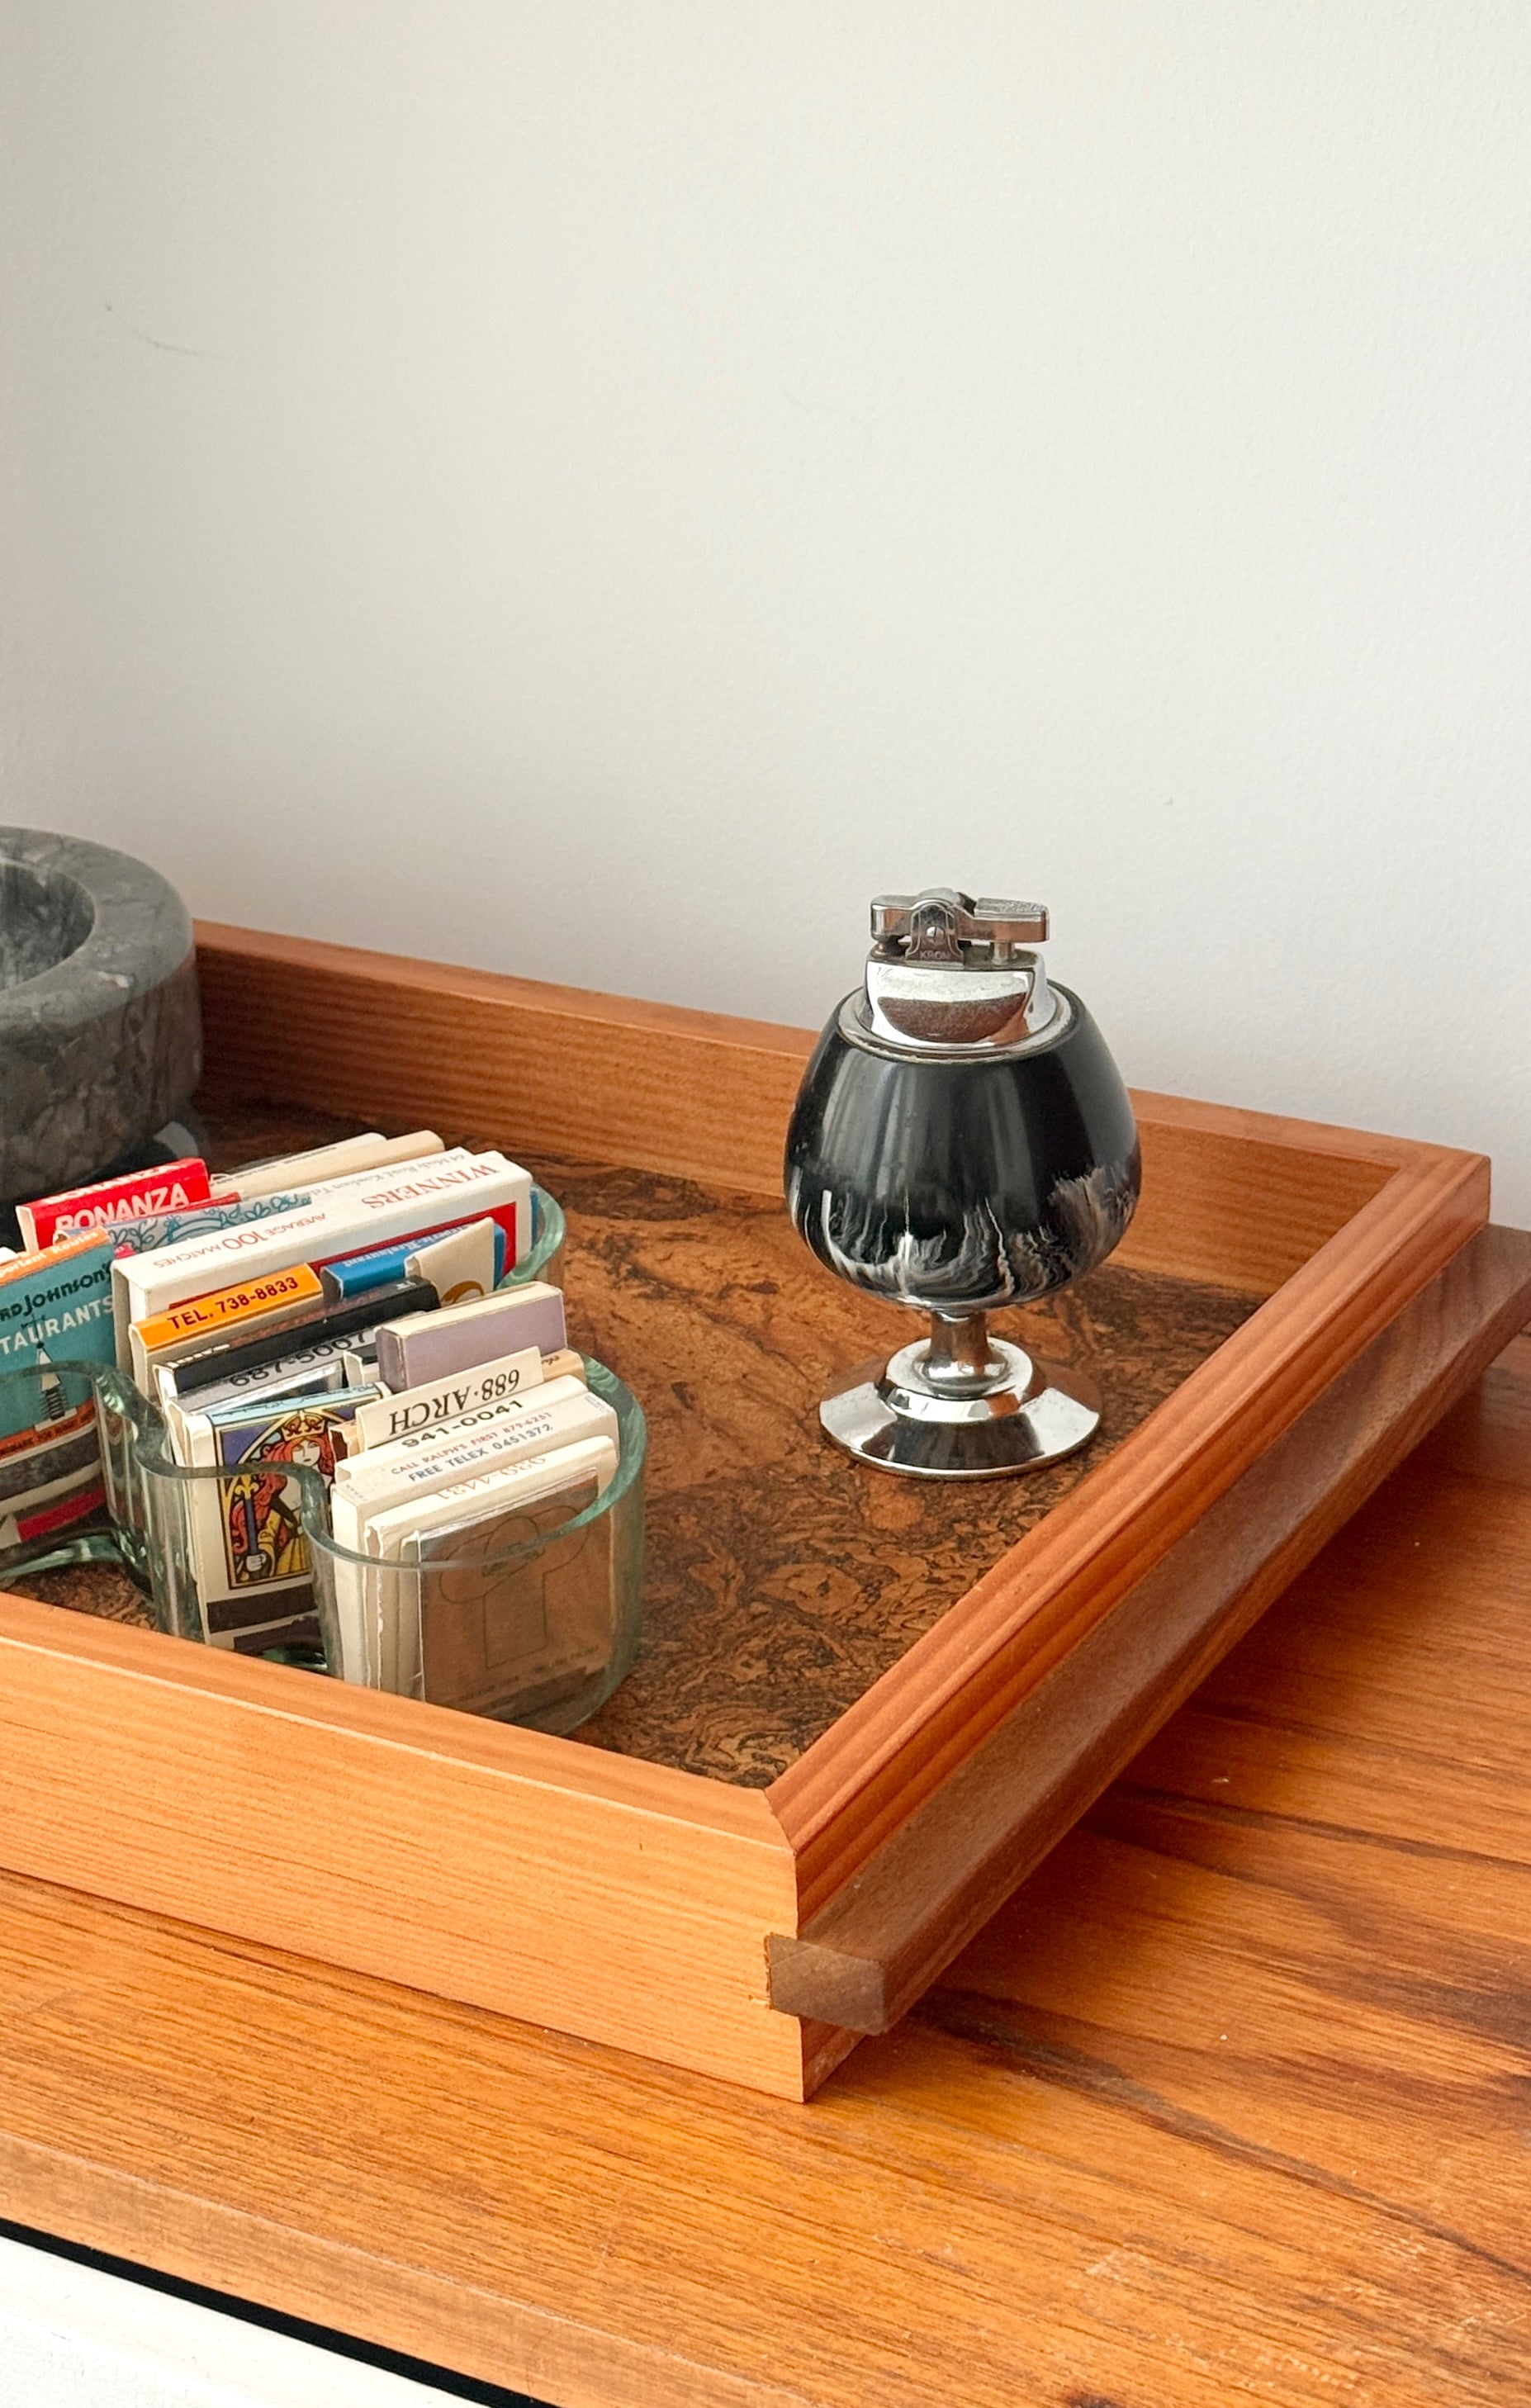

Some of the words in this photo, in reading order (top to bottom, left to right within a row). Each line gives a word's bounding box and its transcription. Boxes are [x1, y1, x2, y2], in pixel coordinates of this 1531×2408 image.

[42, 1164, 180, 1205] BONANZA
[55, 1183, 189, 1230] BONANZA
[361, 1164, 500, 1209] WINNERS
[50, 1230, 100, 1254] Routes
[222, 1230, 268, 1250] 100
[264, 1212, 326, 1237] AVERAGE
[153, 1244, 221, 1269] MATCHES
[0, 1295, 114, 1355] TAURANTS
[167, 1309, 214, 1330] TEL.
[215, 1277, 299, 1314] 738-8833
[230, 1333, 365, 1387] 687-5007
[401, 1400, 524, 1448] 941-0041
[391, 1462, 419, 1475] CALL
[421, 1443, 468, 1463] RALPH'S
[470, 1431, 499, 1446] FIRST
[408, 1467, 443, 1482] FREE
[444, 1447, 490, 1467] TELEX
